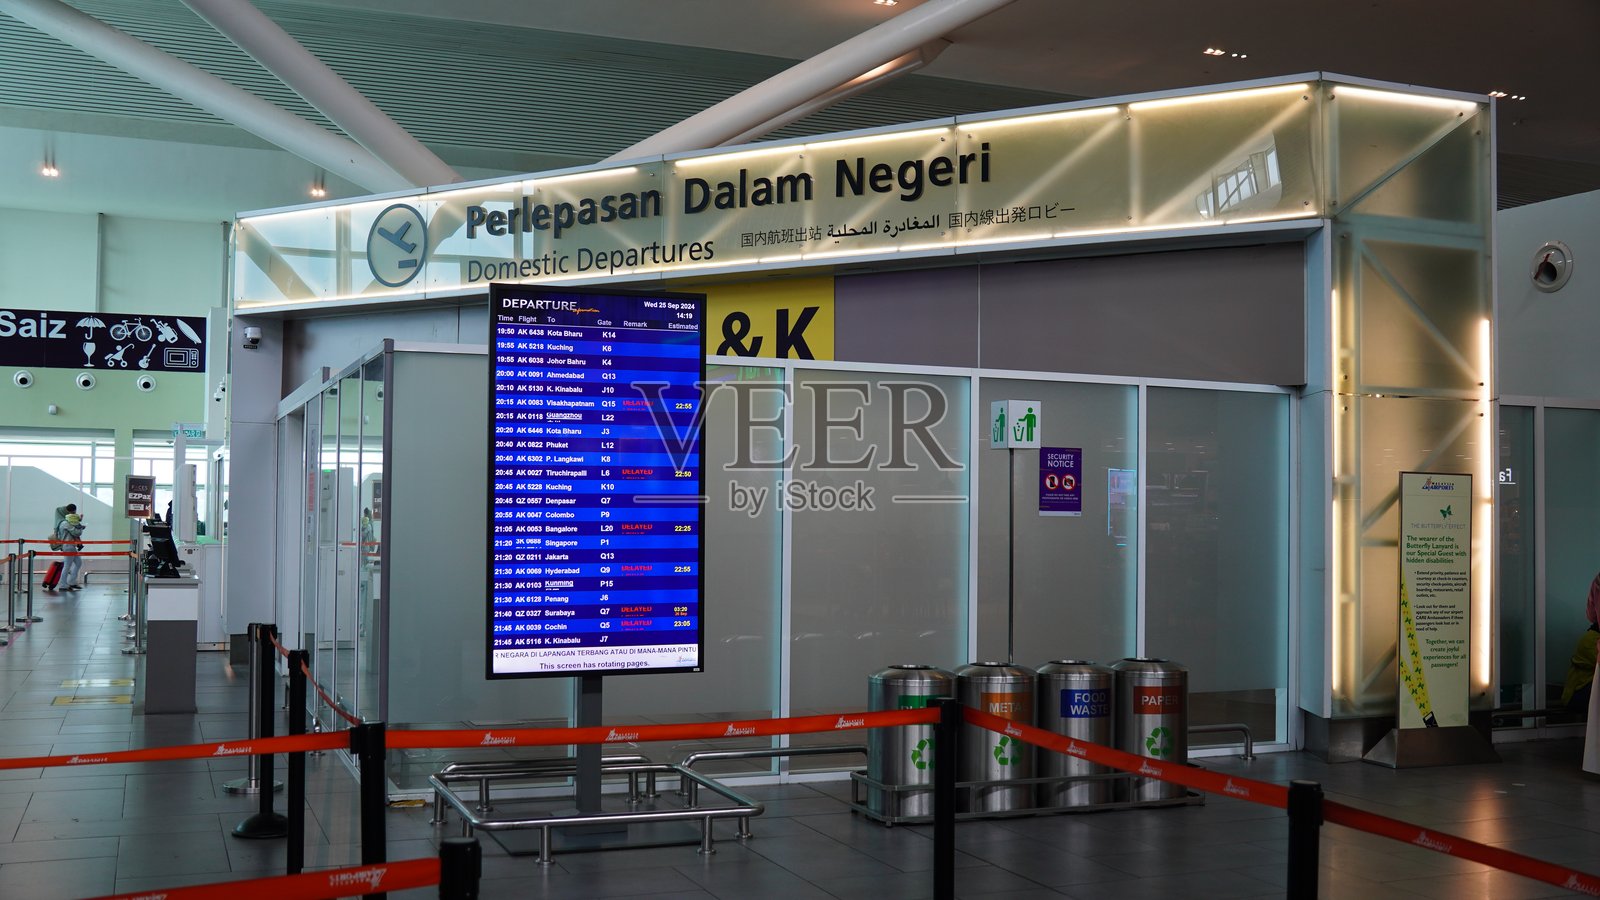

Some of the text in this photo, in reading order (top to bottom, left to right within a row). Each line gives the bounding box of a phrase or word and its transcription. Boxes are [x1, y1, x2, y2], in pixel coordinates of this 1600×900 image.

[466, 142, 991, 239] Perlepasan Dalam Negeri
[949, 203, 1076, 229] 国内線出発ロビー
[827, 215, 940, 243] المغادرة المحلية
[741, 226, 822, 247] 国内航班出站
[468, 240, 714, 282] Domestic Departures
[502, 298, 577, 311] DEPARTURE
[667, 302, 679, 310] Sep
[0, 310, 67, 339] Saiz
[518, 315, 537, 323] Flight
[623, 320, 648, 328] Remark
[668, 322, 699, 330] Estimated
[547, 344, 573, 352] Kuching
[1047, 460, 1074, 468] NOTICE
[500, 651, 529, 659] NEGARA
[540, 662, 555, 670] This
[597, 661, 625, 669] rotating
[626, 660, 650, 669] pages.
[1074, 692, 1106, 703] FOOD
[1141, 695, 1178, 706] PAPER
[1070, 704, 1109, 716] WASTE
